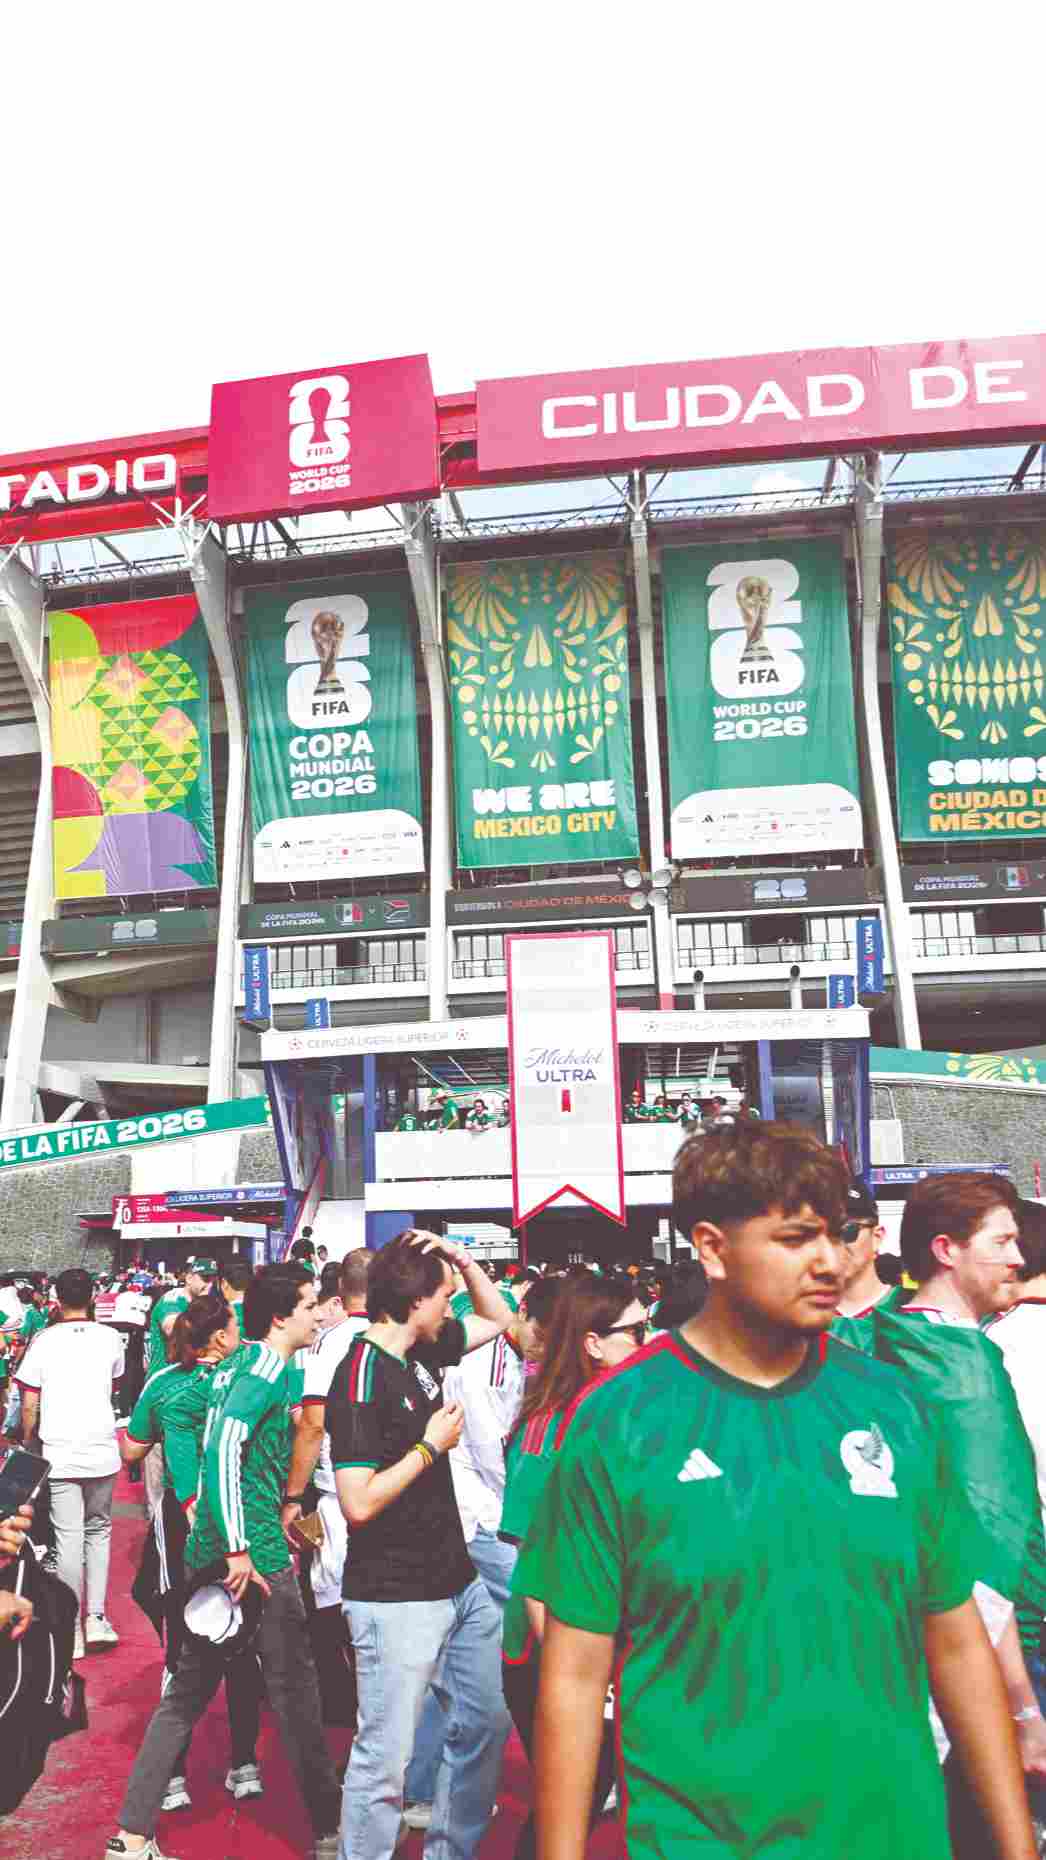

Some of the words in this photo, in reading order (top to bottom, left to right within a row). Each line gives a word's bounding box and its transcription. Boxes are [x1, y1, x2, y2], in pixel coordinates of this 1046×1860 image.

[542, 373, 865, 439] CIUDAD
[909, 360, 1028, 409] DE
[0, 453, 177, 512] TADIO
[288, 466, 328, 480] WORLD
[329, 464, 351, 476] CUP
[288, 474, 352, 495] 2026
[738, 668, 780, 685] FIFA
[311, 700, 350, 716] FIFA
[712, 702, 771, 719] WORLD
[773, 700, 808, 714] CUP
[713, 715, 808, 742] 2026
[289, 730, 375, 760] COPA
[290, 756, 376, 778] MUNDIAL
[291, 774, 377, 800] 2026
[473, 786, 533, 815] WE
[539, 779, 617, 811] ARE
[929, 790, 1027, 810] CIUDAD
[474, 815, 562, 840] MEXICO
[567, 811, 617, 832] CITY
[929, 808, 1046, 832] MÉXIC
[535, 1068, 598, 1083] ULTRA
[21, 1135, 53, 1159] LA
[56, 1125, 111, 1153] FIFA
[116, 1109, 207, 1143] 2026
